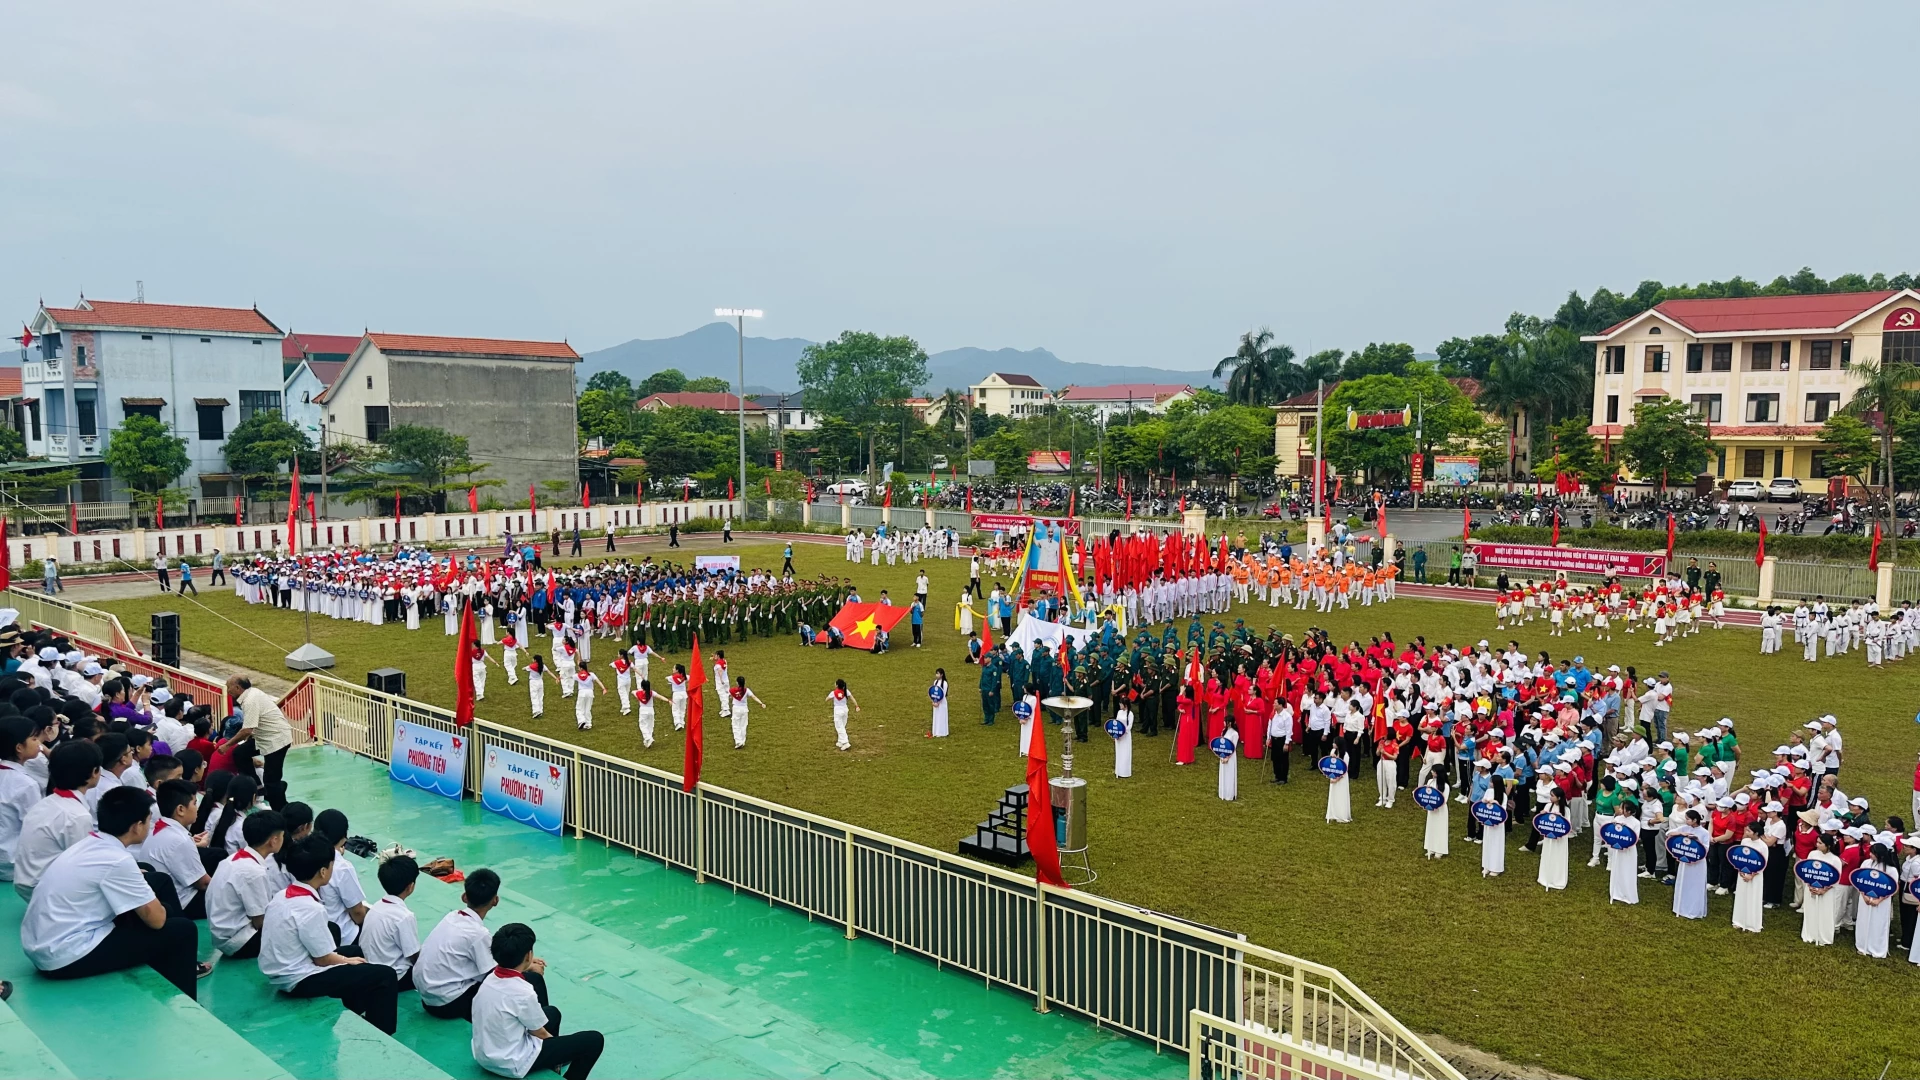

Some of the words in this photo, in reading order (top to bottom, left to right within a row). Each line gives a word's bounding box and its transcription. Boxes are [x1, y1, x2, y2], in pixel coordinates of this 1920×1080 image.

[1562, 551, 1572, 559] ĐỘNG
[414, 737, 428, 746] TẬP
[430, 739, 443, 750] KẾT
[408, 749, 432, 770] PHƯƠNG
[433, 755, 447, 777] TIỆN
[507, 763, 522, 774] TẬP
[524, 766, 540, 780] KẾT
[500, 777, 527, 800] PHƯƠNG
[528, 785, 544, 807] TIỆN
[1876, 882, 1887, 890] PHỐ
